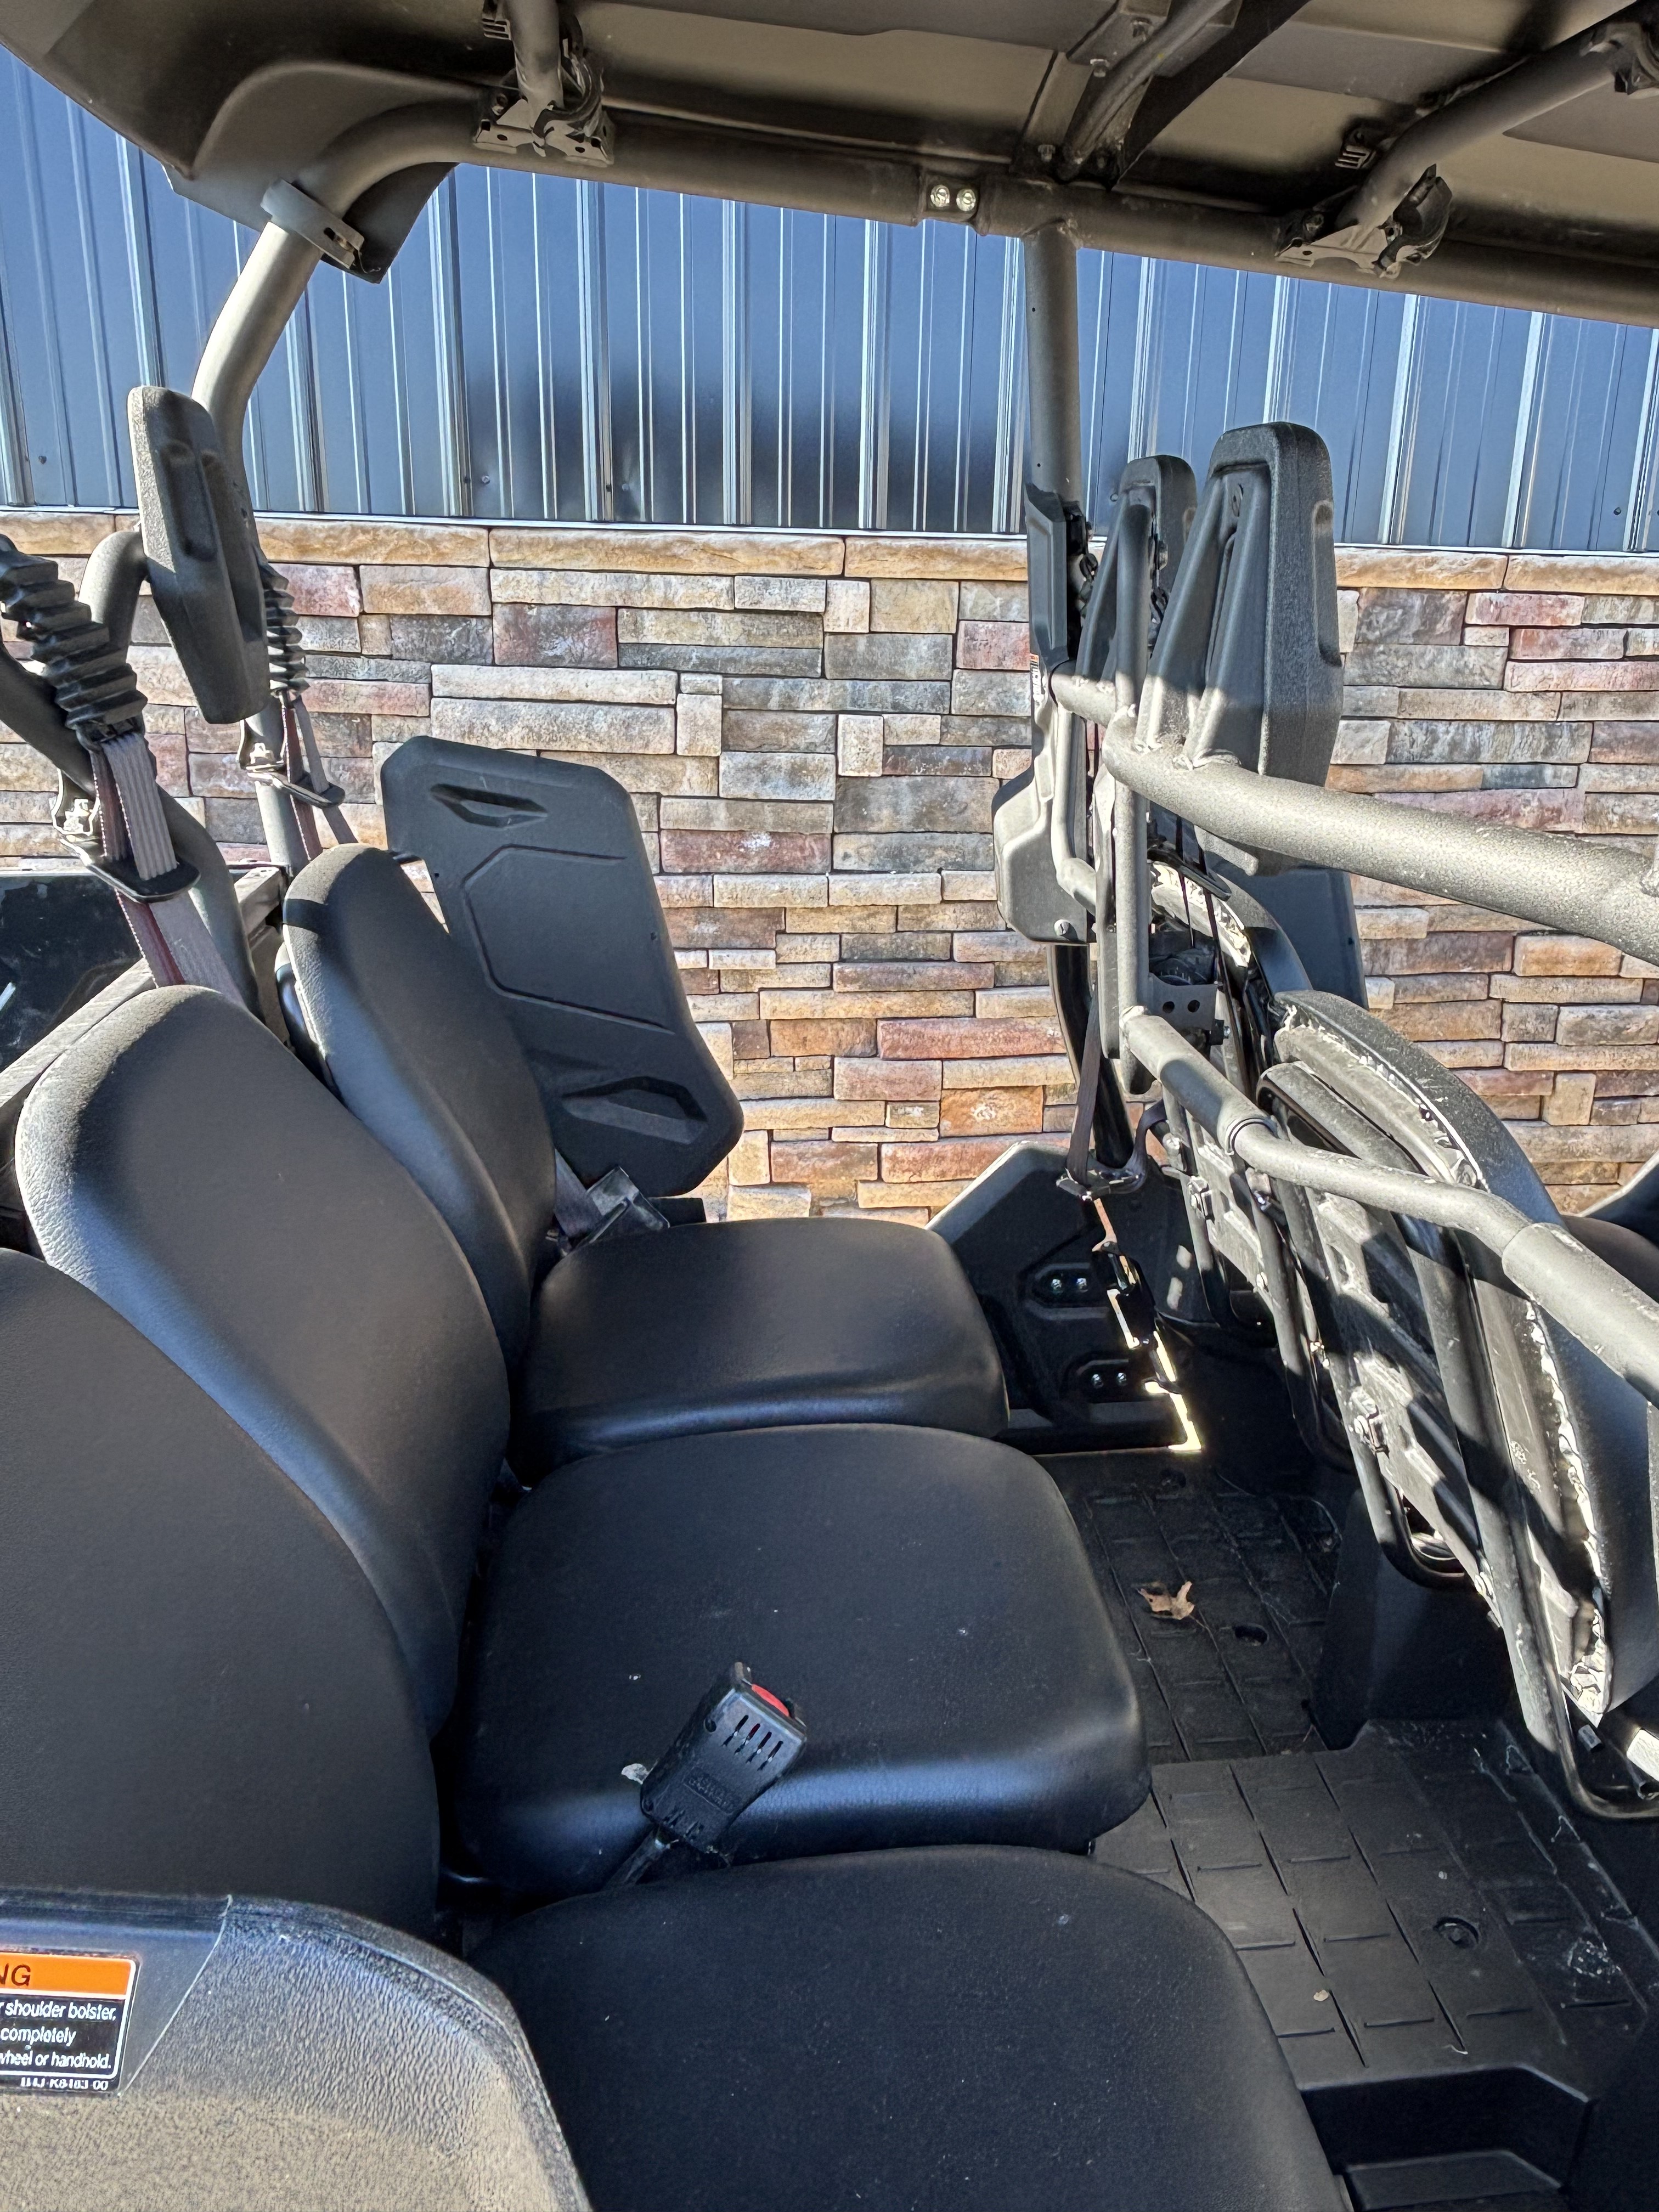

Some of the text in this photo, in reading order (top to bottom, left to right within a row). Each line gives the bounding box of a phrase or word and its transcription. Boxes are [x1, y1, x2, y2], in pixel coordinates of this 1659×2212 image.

[5, 1999, 66, 2018] shoulder
[68, 2002, 116, 2021] bolster,
[1, 2026, 76, 2047] completely
[35, 2054, 49, 2066] or
[51, 2051, 111, 2069] handhold.
